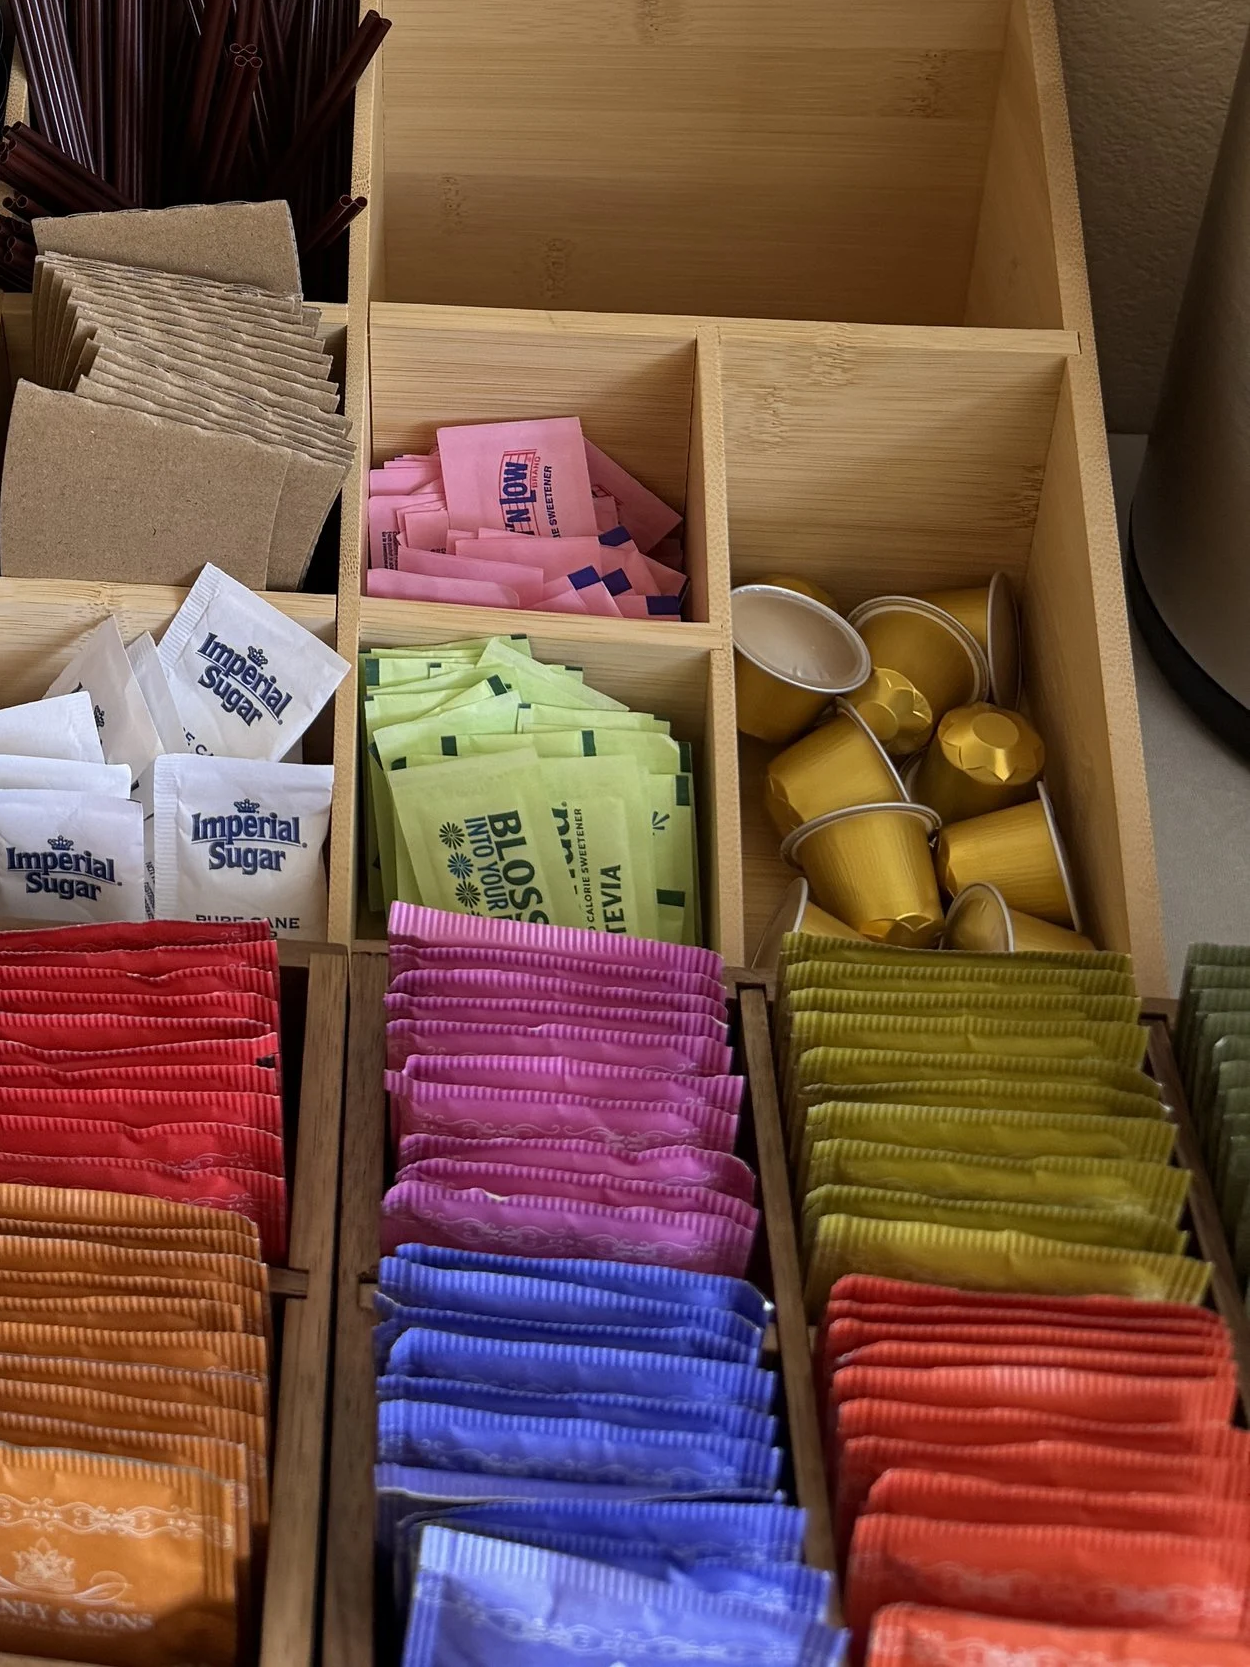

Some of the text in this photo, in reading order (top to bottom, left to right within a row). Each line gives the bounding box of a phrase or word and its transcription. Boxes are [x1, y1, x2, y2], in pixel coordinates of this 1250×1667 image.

[499, 461, 537, 505] LOW
[531, 456, 541, 488] BRAND
[543, 465, 558, 526] SWEETENER
[197, 632, 293, 719] Imperial
[197, 664, 263, 726] Sugar
[191, 812, 301, 845] Imperial
[464, 816, 495, 858] INTO
[574, 808, 588, 873] SWEETENER
[6, 847, 115, 883] Imperial
[209, 842, 286, 875] Sugar
[26, 872, 102, 901] Sugar
[477, 861, 509, 911] YOUR
[582, 877, 594, 922] CALORIE
[600, 865, 627, 934] TEVIA
[57, 1608, 79, 1626] &
[85, 1610, 154, 1630] SONS
